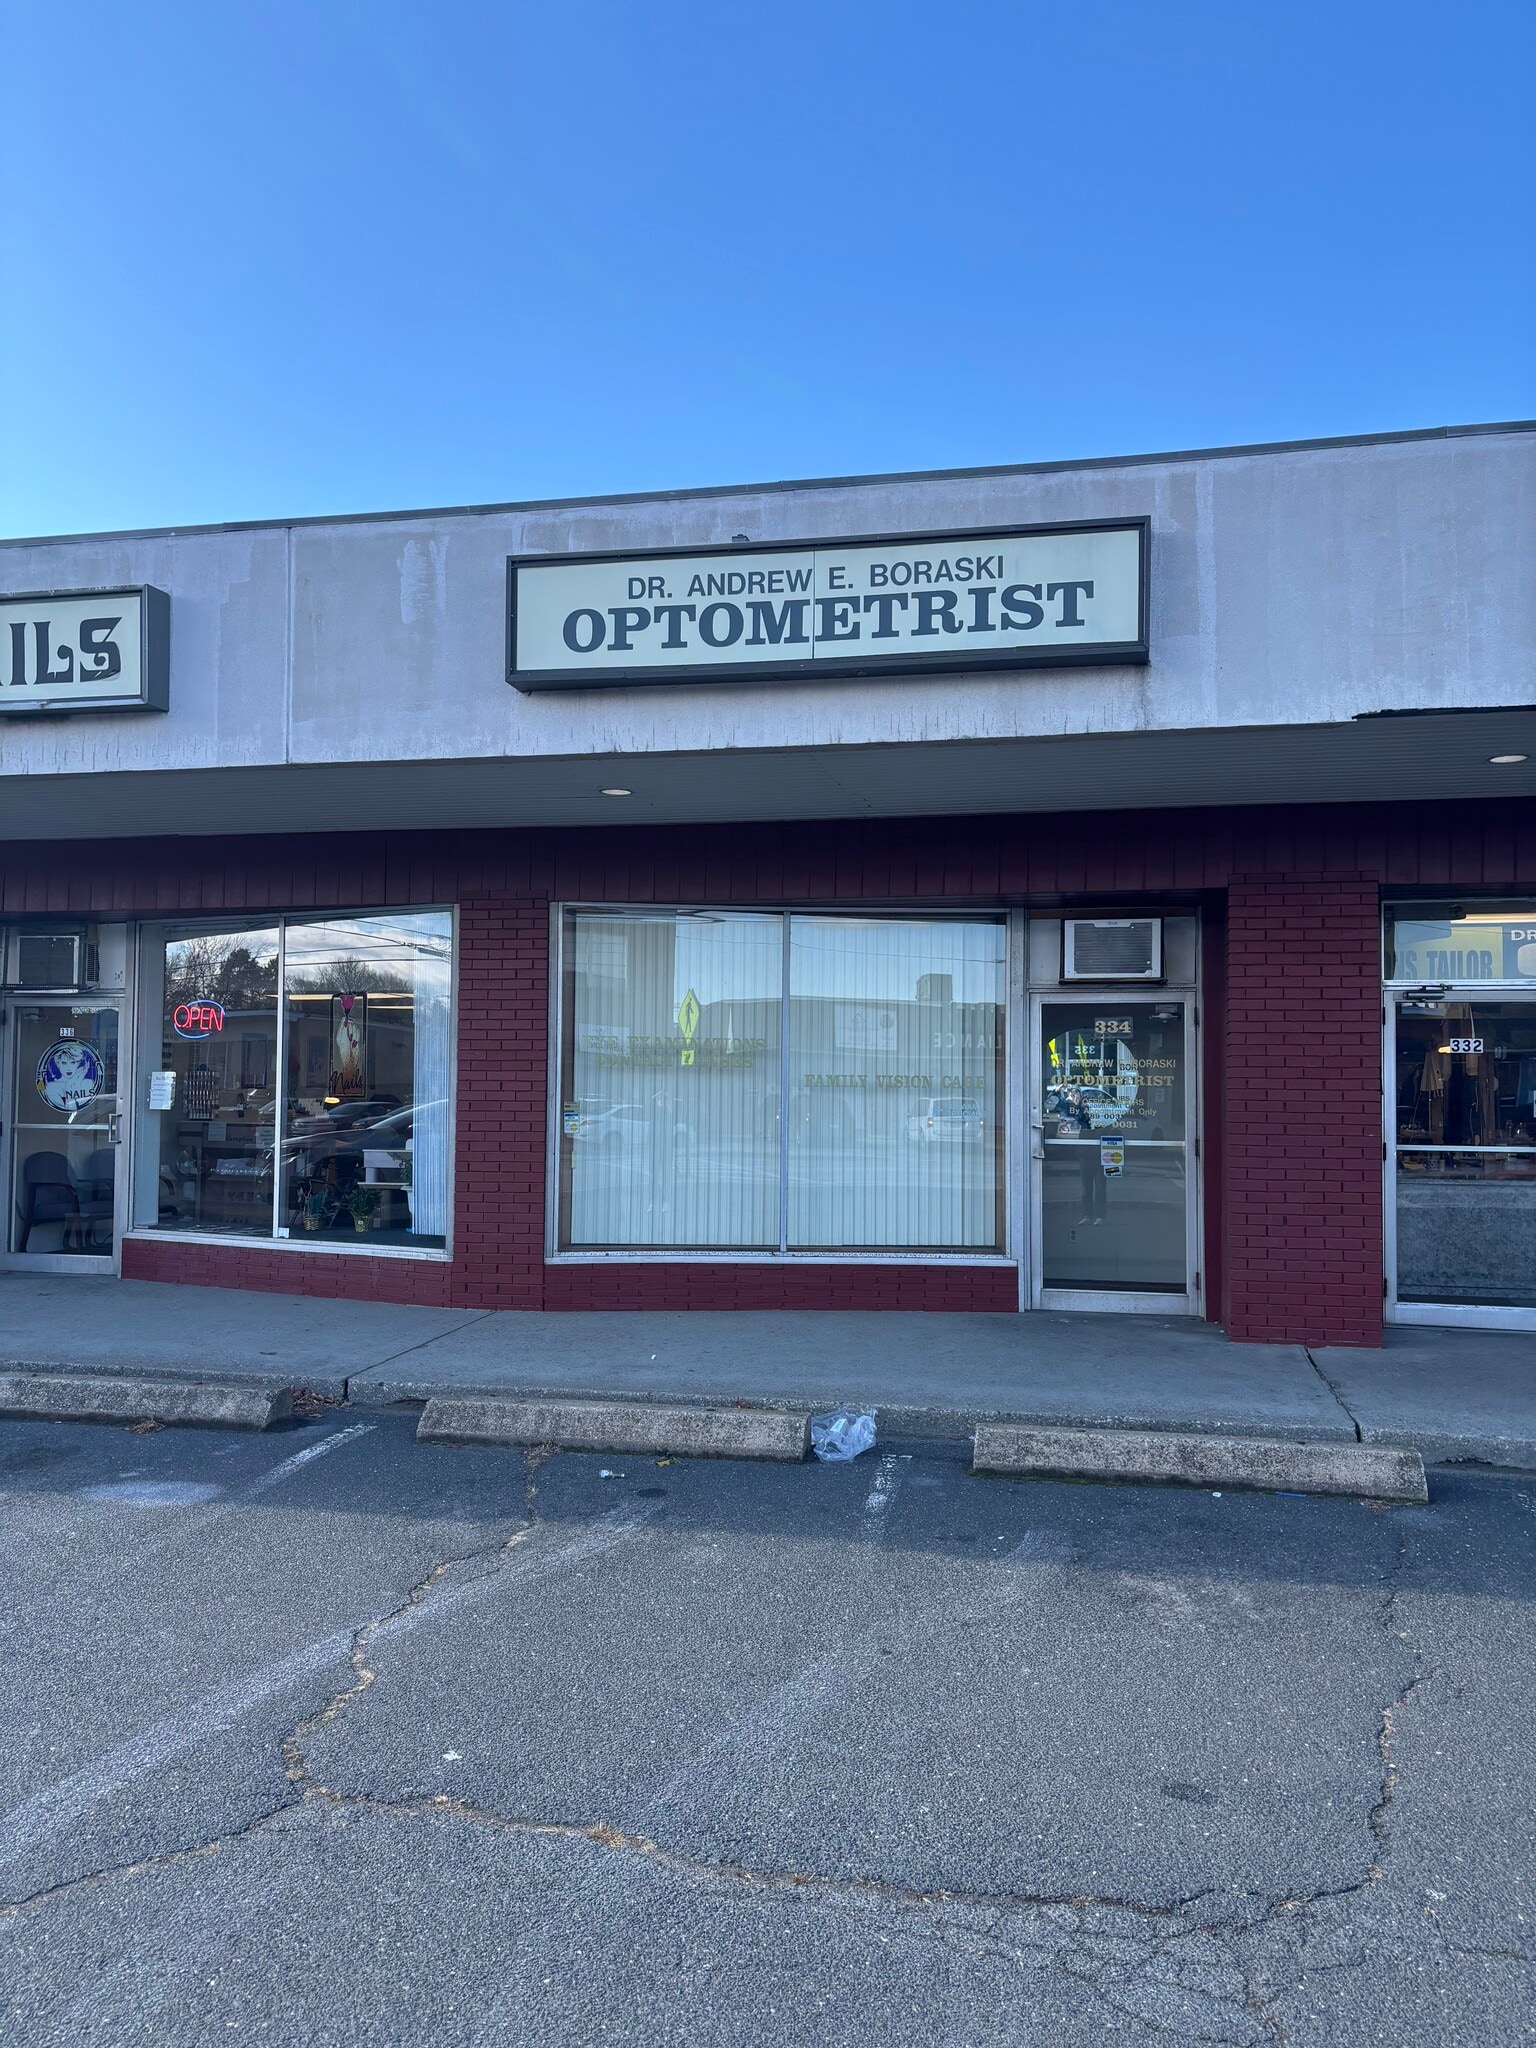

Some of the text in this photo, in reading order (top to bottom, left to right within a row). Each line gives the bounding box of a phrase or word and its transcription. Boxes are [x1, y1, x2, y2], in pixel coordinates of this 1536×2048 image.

[628, 555, 1004, 600] DR. ANDREW E. BORASKI
[562, 580, 1095, 653] OPTOMETRIST
[0, 616, 123, 687] ILS
[1426, 950, 1493, 980] TAILOR
[173, 1004, 224, 1032] OPEN
[1094, 1020, 1131, 1034] 334
[627, 1036, 768, 1051] EXAMINATIONS
[1450, 1040, 1482, 1053] 332
[1071, 1059, 1114, 1068] ANDREW
[330, 1068, 363, 1096] Nails
[804, 1074, 986, 1090] FAMILY VISION CARE
[65, 1088, 96, 1100] NAILS
[1082, 1098, 1112, 1106] OFFICE
[1069, 1106, 1158, 1117] By Appointment Only
